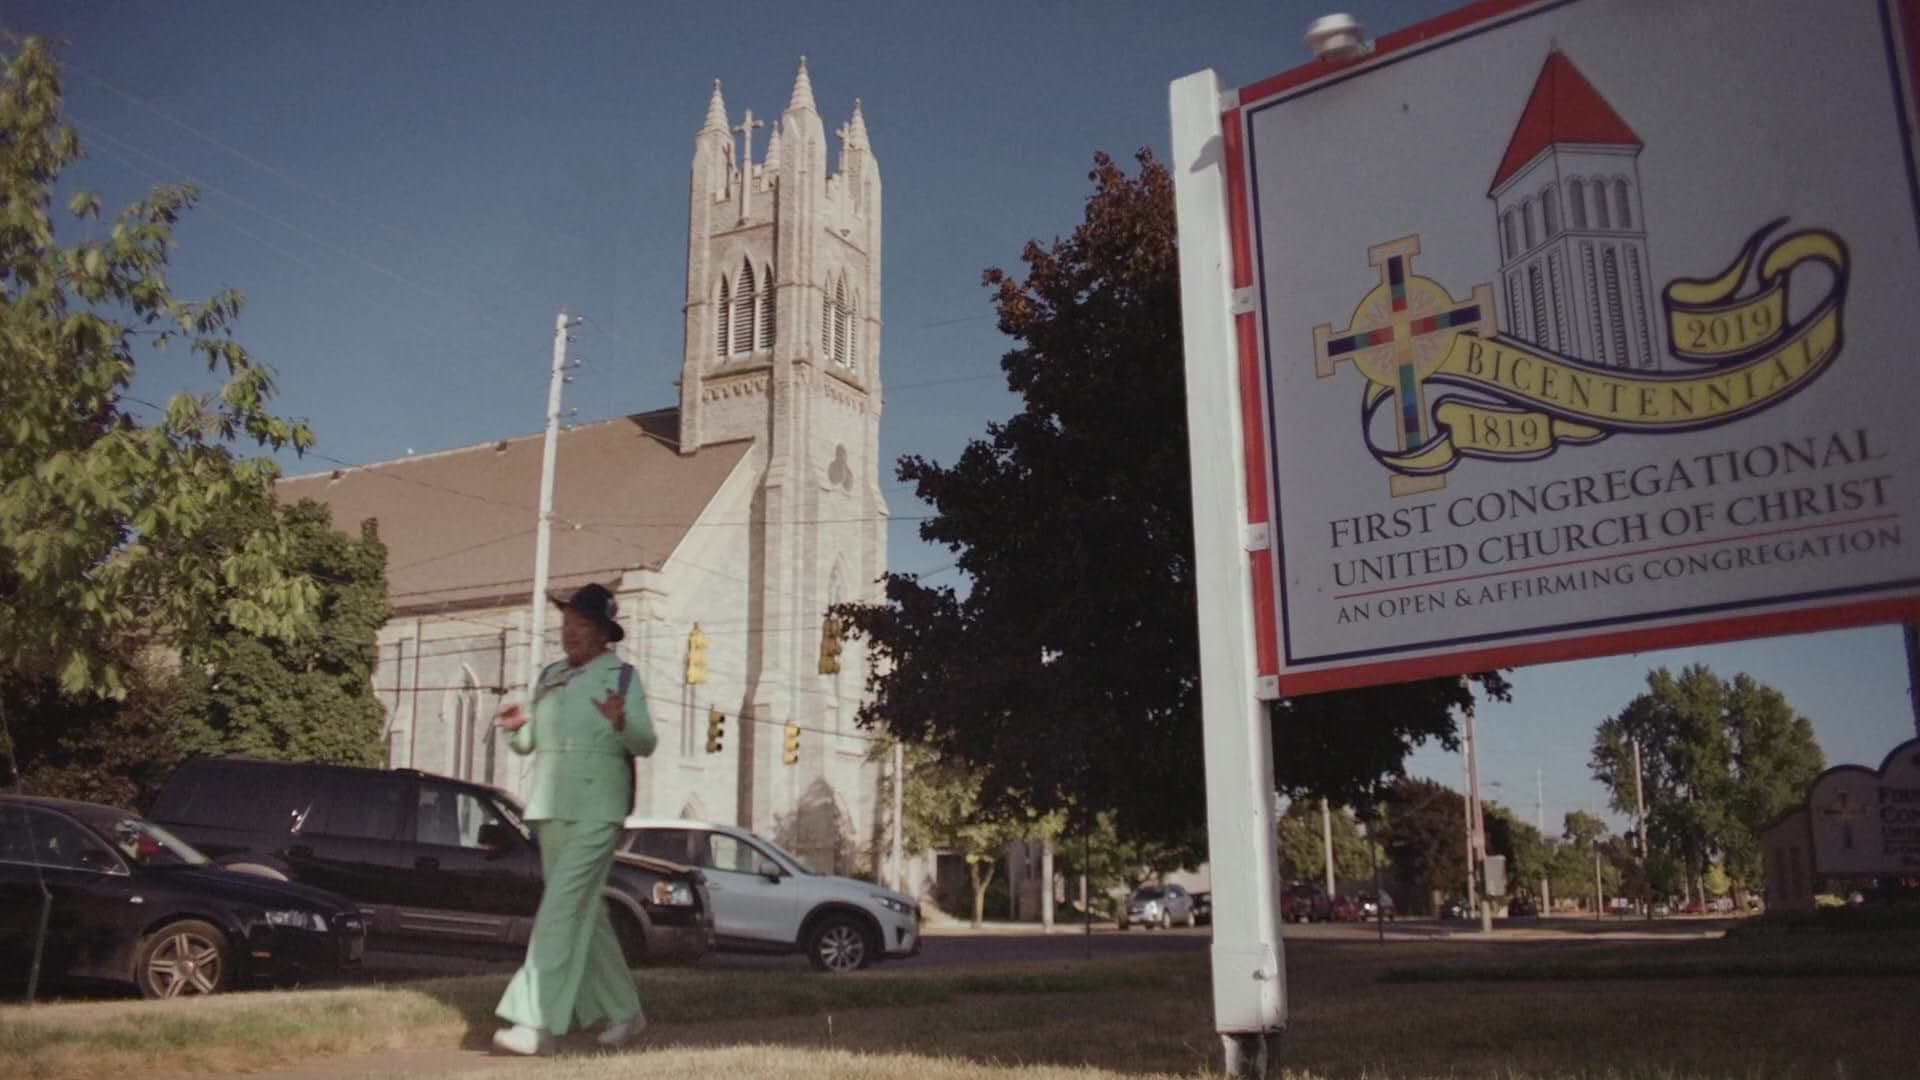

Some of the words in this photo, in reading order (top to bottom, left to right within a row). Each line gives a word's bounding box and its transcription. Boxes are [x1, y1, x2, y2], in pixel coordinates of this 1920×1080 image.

[1687, 304, 1772, 348] 2019
[1464, 338, 1825, 418] BICENTENNIAL
[1467, 412, 1539, 449] 1819
[1328, 503, 1437, 549] FIRST
[1447, 428, 1888, 528] CONGREGATIONAL
[1332, 542, 1468, 587] UNITED
[1478, 512, 1649, 565] CHURCH
[1660, 502, 1715, 536] OF
[1727, 474, 1893, 527] CHRIST
[1336, 602, 1370, 625] AN
[1377, 591, 1446, 619] OPEN
[1454, 587, 1473, 607] &
[1478, 563, 1635, 605] AFFIRMING
[1642, 523, 1901, 582] CONGREGATION
